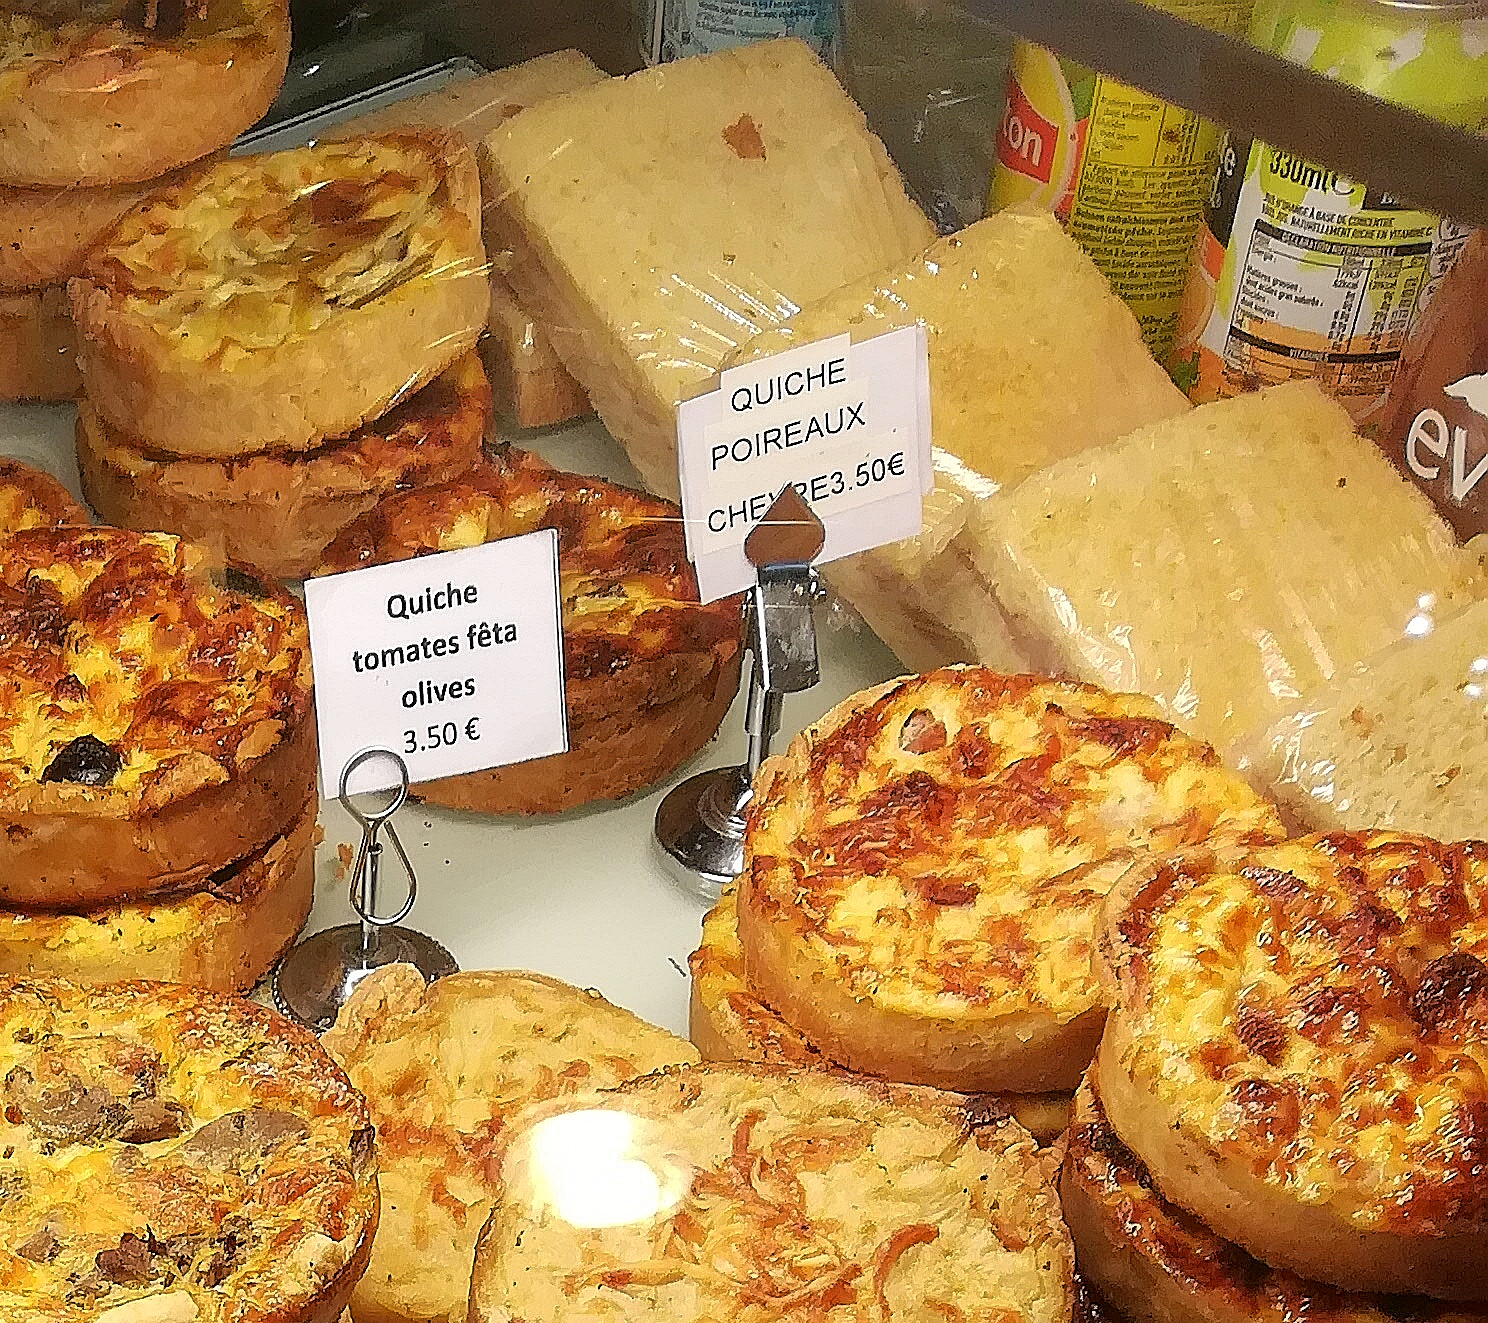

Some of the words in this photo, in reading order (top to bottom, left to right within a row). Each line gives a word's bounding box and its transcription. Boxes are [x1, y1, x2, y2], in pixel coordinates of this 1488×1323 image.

[731, 357, 847, 412] QUICHE
[711, 401, 866, 471] POIREAUX
[707, 451, 906, 533] CHEE3.50€
[387, 582, 478, 620] Quiche
[352, 634, 460, 673] tomates
[467, 622, 518, 651] fêta
[401, 677, 476, 708] olives
[403, 721, 458, 754] 3.50
[464, 717, 481, 742] €
